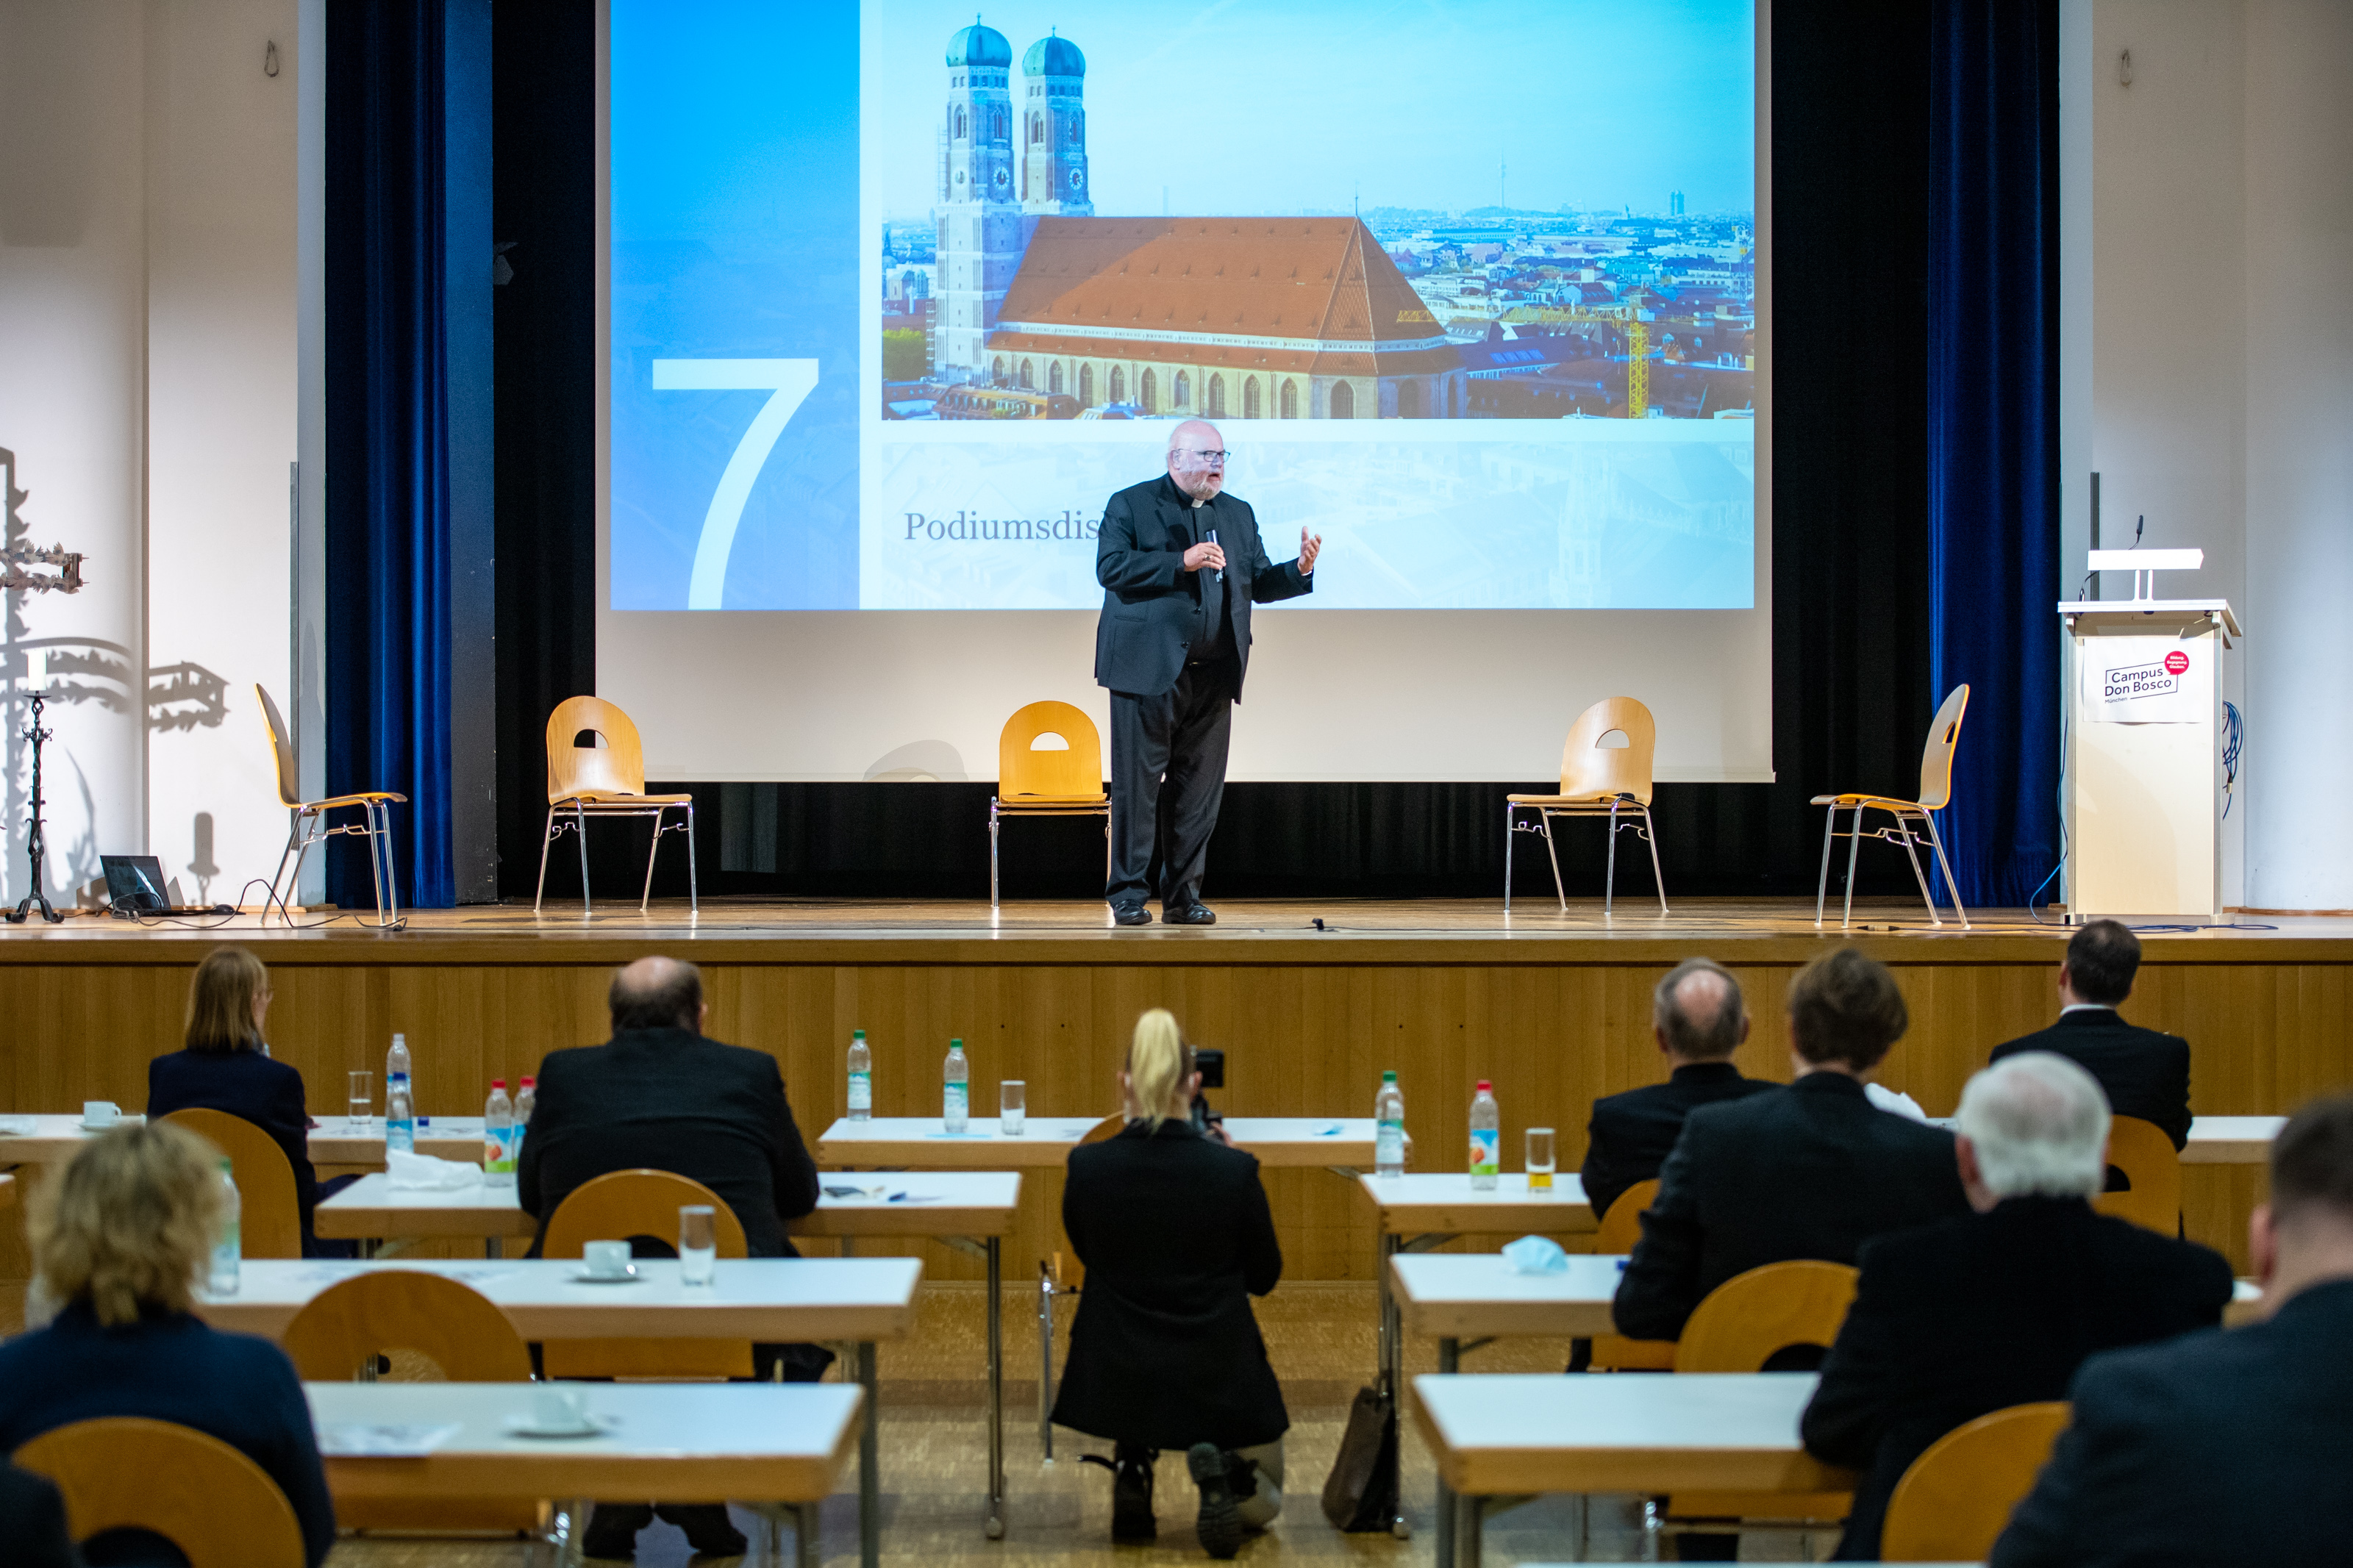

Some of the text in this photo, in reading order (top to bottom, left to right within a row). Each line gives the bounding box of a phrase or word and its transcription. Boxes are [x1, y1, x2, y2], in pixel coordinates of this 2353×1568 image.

[652, 358, 819, 609] 7
[904, 510, 1104, 540] Podiumsdis
[2112, 668, 2163, 683] Campus
[2104, 679, 2171, 696] Don Bosco
